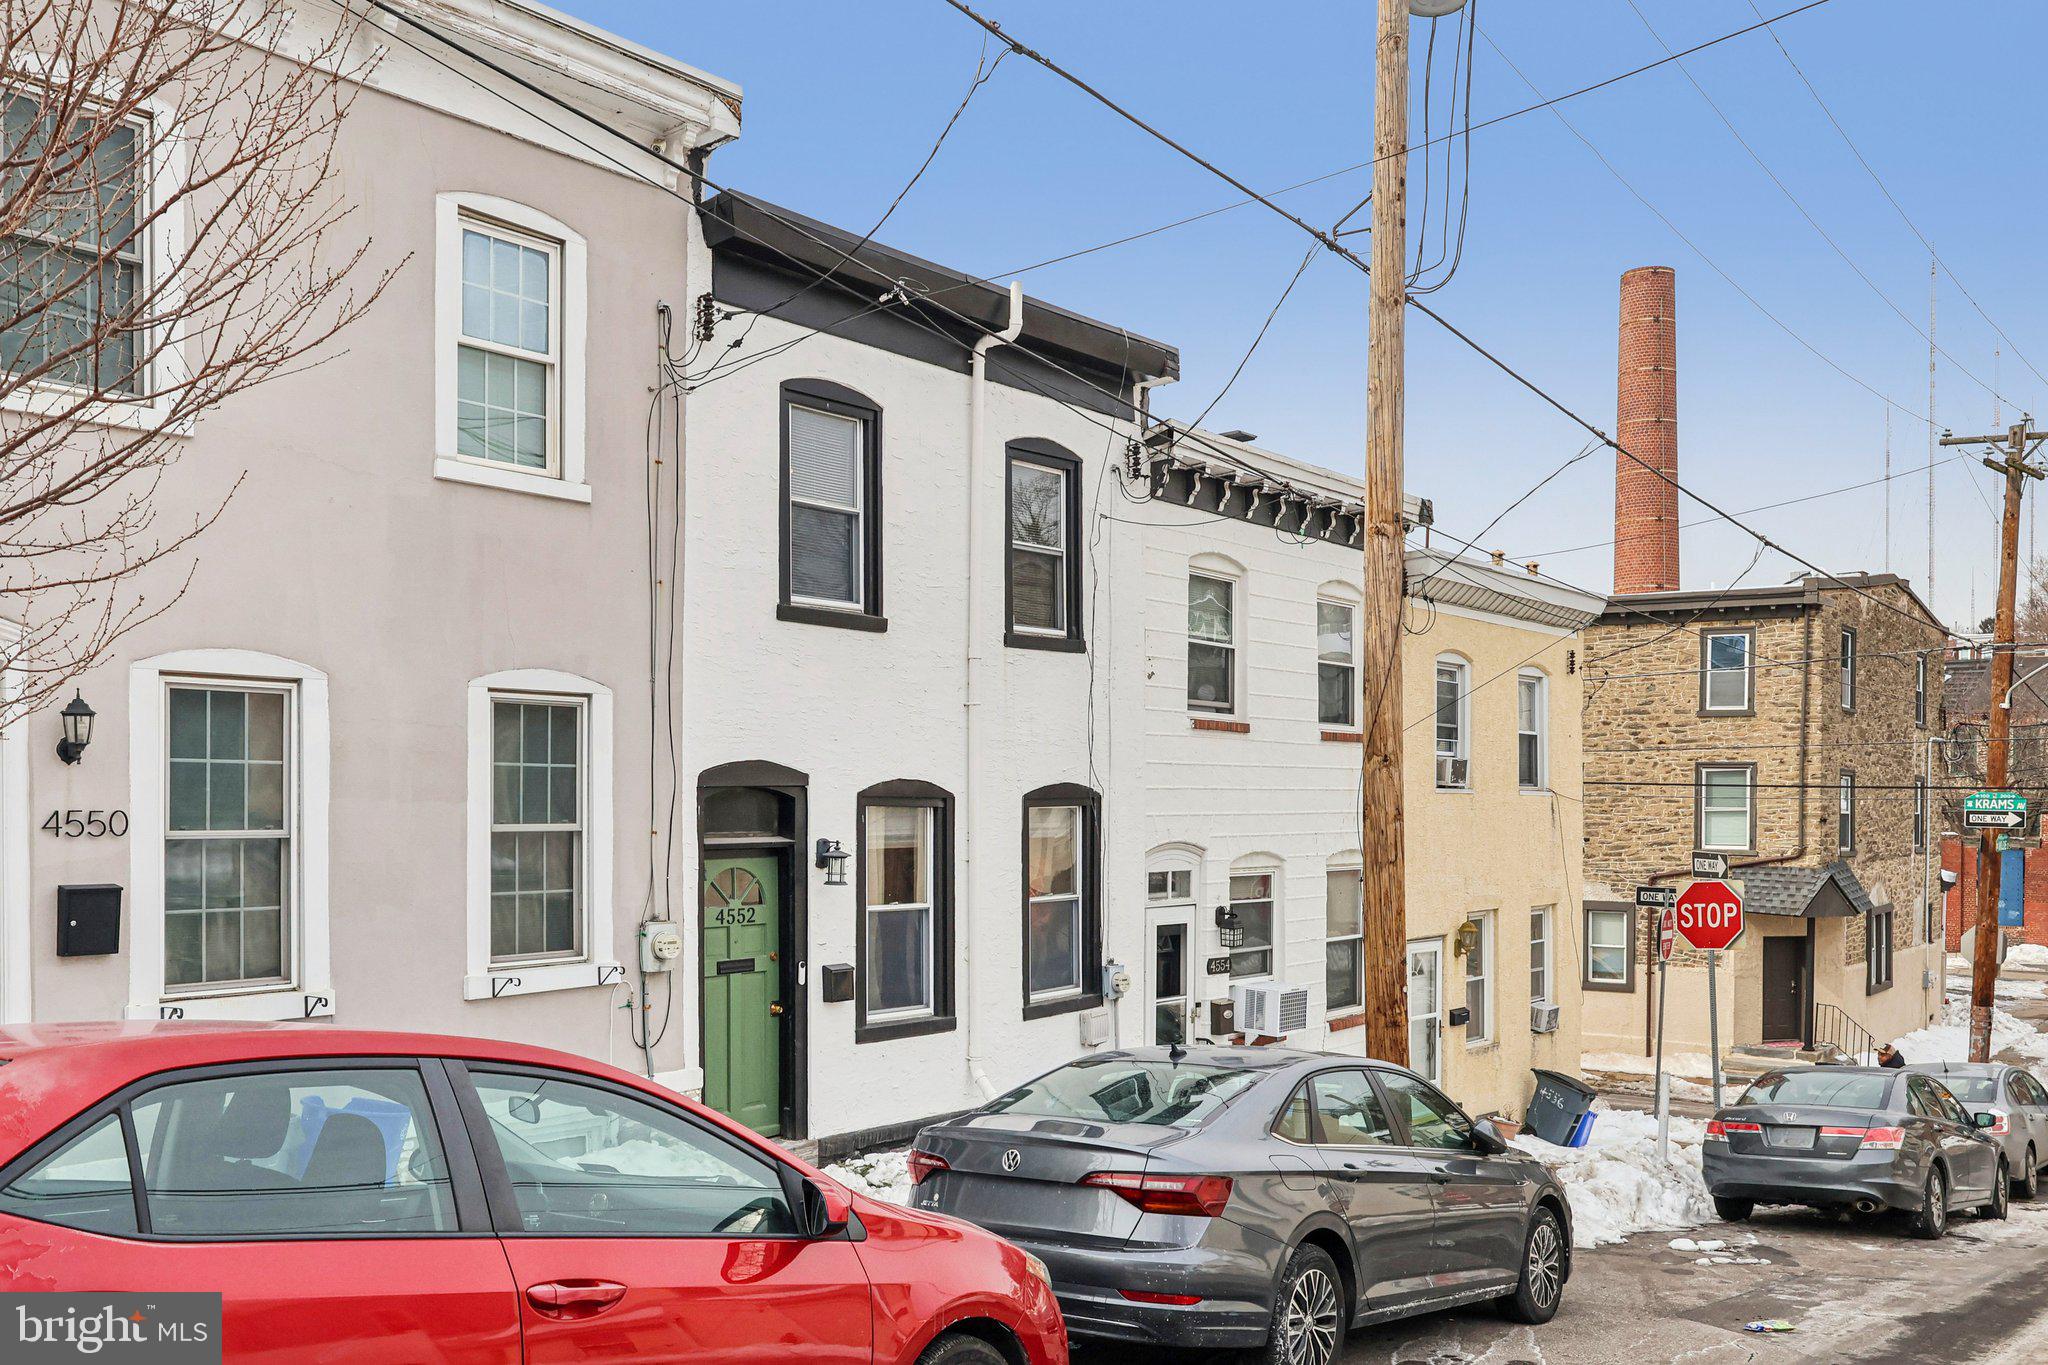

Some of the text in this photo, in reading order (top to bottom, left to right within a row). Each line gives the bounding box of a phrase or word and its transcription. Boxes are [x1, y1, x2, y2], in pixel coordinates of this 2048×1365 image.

[1975, 799, 2014, 809] KRAMS
[41, 809, 129, 838] 4550
[1695, 859, 1719, 871] ONE WAY
[1642, 892, 1659, 901] ONE
[715, 907, 756, 925] 4552
[1680, 902, 1738, 928] STOP
[1210, 958, 1231, 973] 4554
